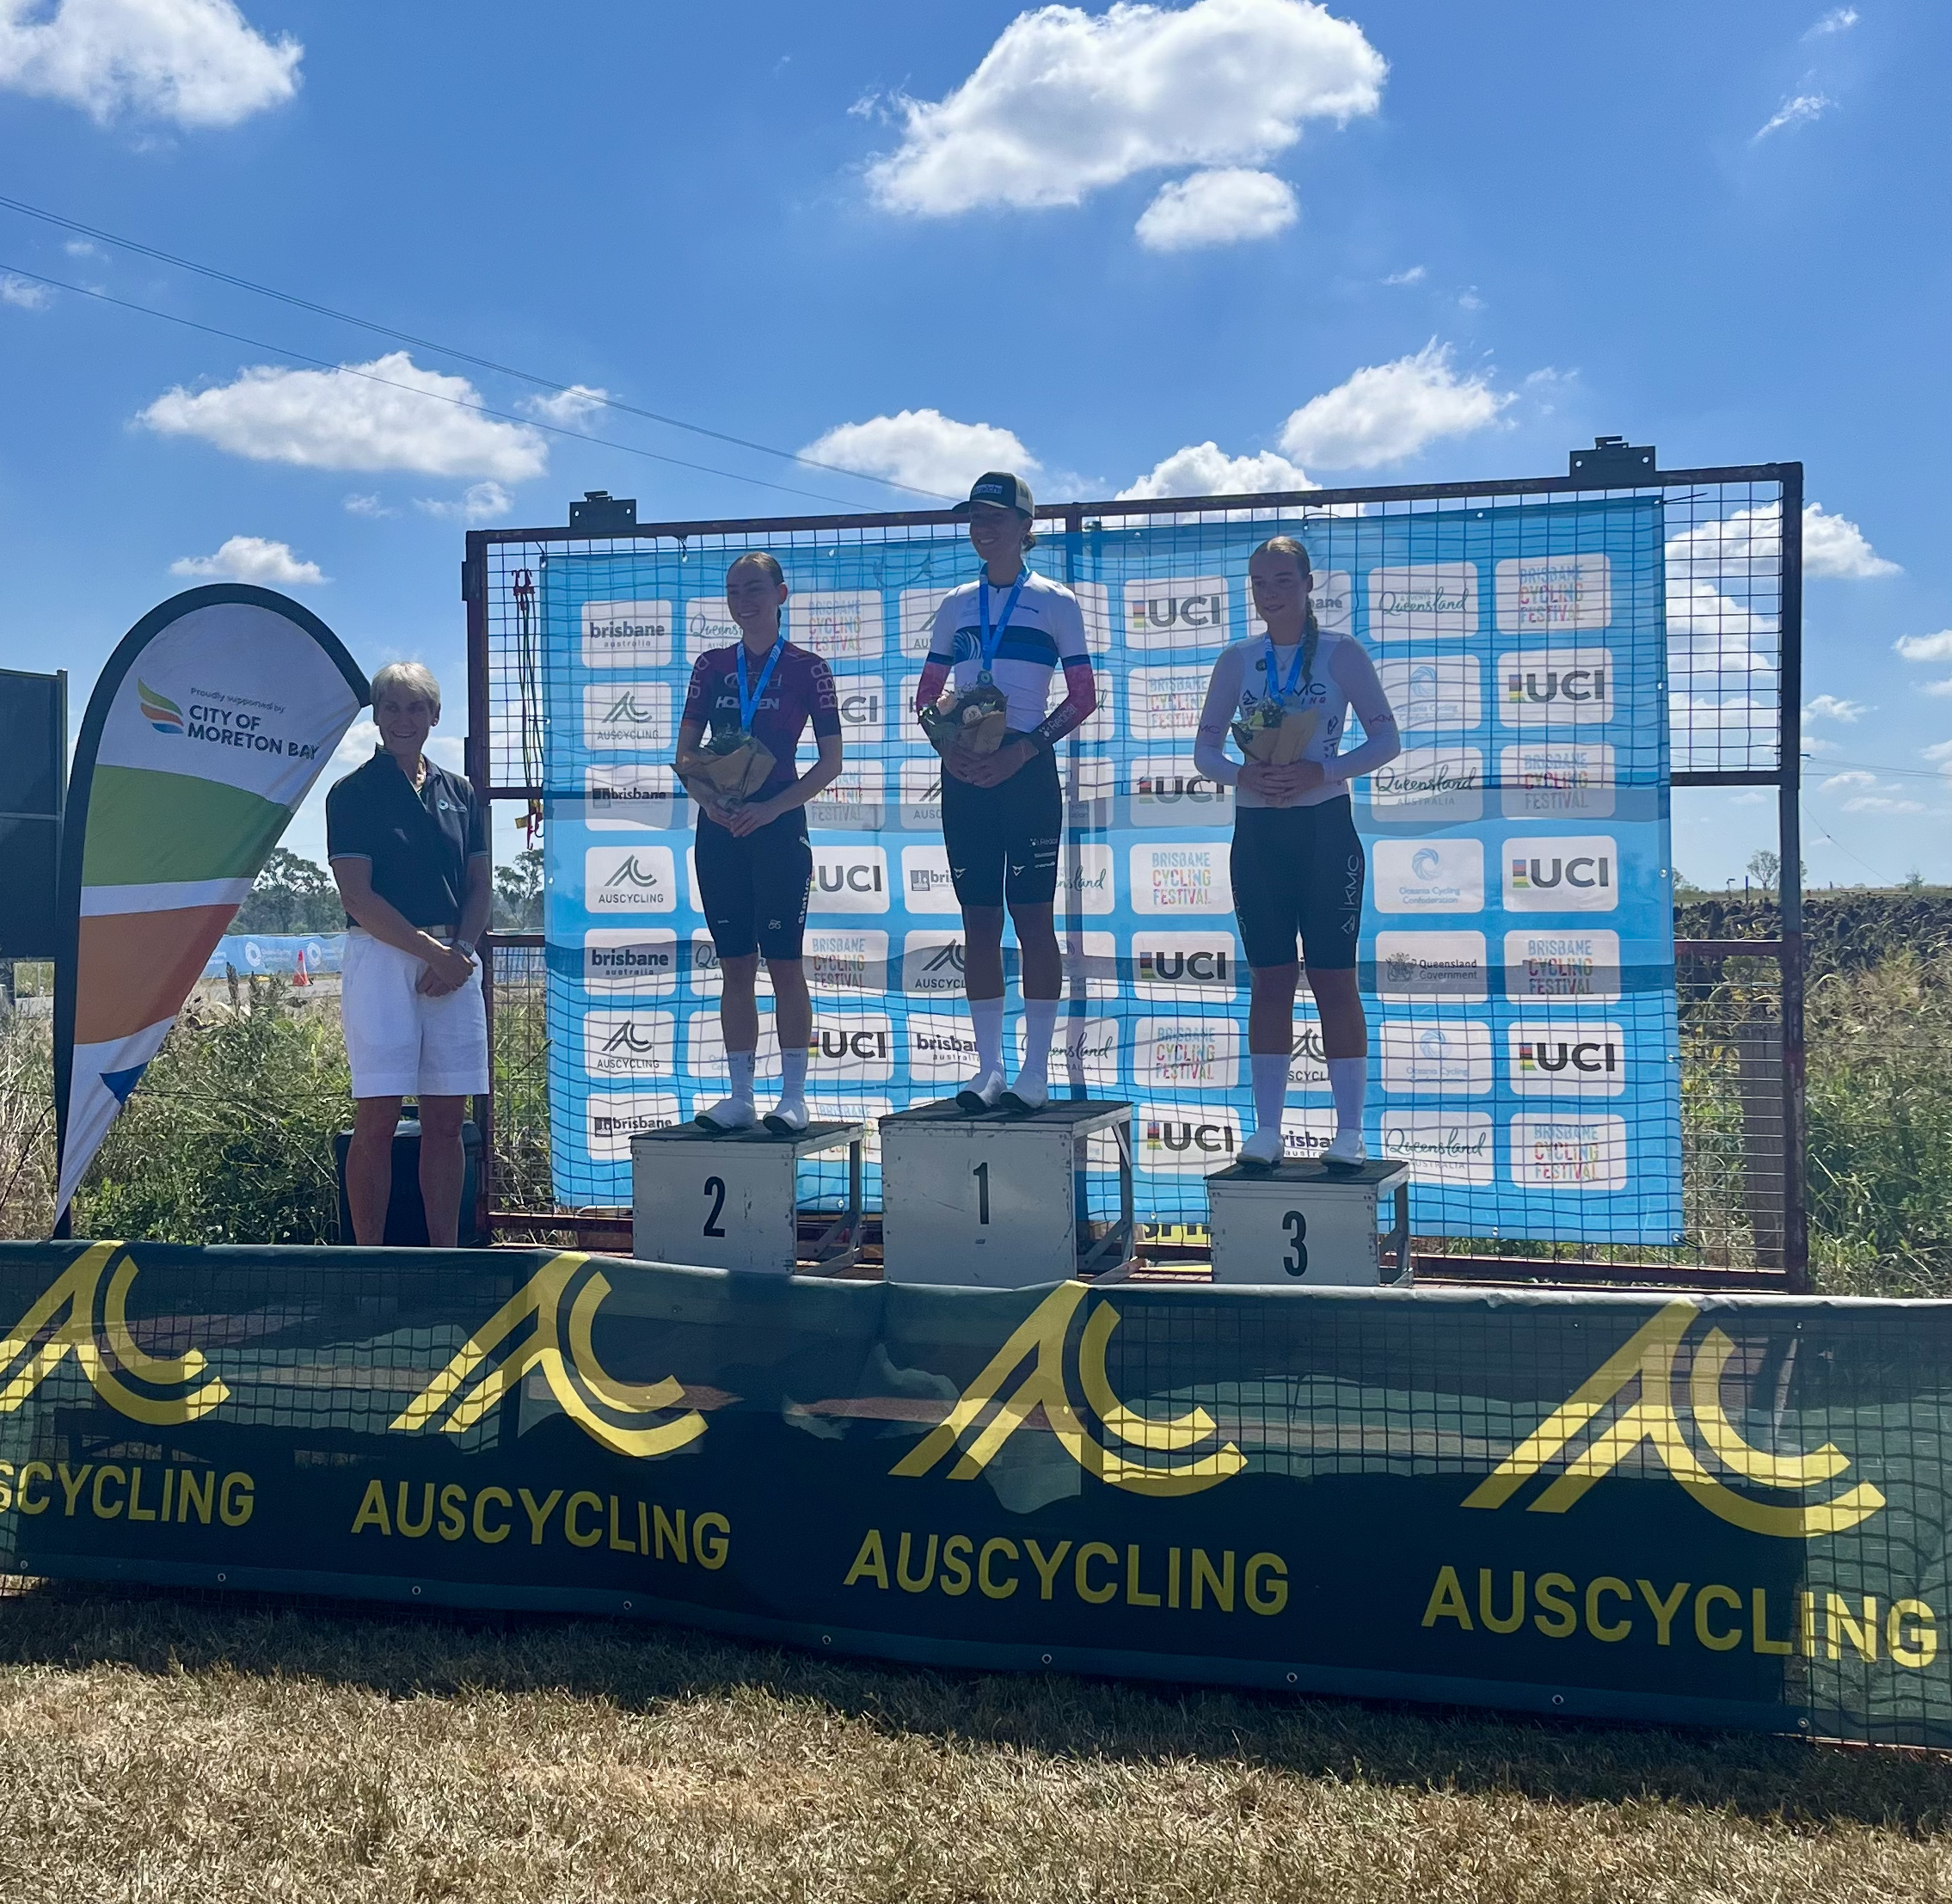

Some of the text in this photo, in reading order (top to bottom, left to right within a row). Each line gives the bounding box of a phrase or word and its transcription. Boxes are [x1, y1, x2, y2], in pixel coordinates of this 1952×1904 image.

[1379, 587, 1469, 616] Queensland
[1148, 596, 1220, 628] UCI
[589, 621, 665, 638] brisbane
[690, 613, 743, 638] Queens
[190, 688, 225, 702] Proudly
[1526, 670, 1604, 703] UCI
[189, 704, 261, 731] CITY OF
[841, 695, 878, 723] CI
[187, 722, 320, 760] MORETON BAY
[597, 730, 659, 740] AUSCYCLING
[1156, 775, 1225, 803] UCI
[1376, 765, 1476, 795] Queensland
[611, 788, 666, 800] brisbane
[1398, 797, 1455, 806] AUSTRALIA
[1525, 793, 1589, 809] FESTIVAL
[1152, 851, 1211, 868] BRISBANE
[819, 865, 881, 892] UCI
[1152, 869, 1212, 887] CYCLING
[1344, 854, 1360, 906] KMC
[1531, 857, 1608, 888] UCI
[598, 894, 664, 904] AUSCYCLING
[1153, 889, 1212, 906] FESTIVAL
[1432, 887, 1460, 896] Cycling
[812, 938, 866, 953] BRISBANE
[1528, 940, 1593, 955] BRISBANE
[592, 949, 669, 967] brisbane
[813, 955, 865, 972] CYCLING
[1156, 951, 1226, 980] UCI
[1420, 959, 1477, 969] Queensland
[1528, 958, 1593, 977] CYCLING
[605, 967, 654, 975] australia
[1420, 970, 1477, 980] Government
[915, 978, 966, 989] AUSCYCL
[1529, 979, 1594, 995] FESTIVAL
[822, 1031, 887, 1059] UCI
[917, 1033, 978, 1052] brisba
[1157, 1044, 1215, 1061] CYCLING
[1537, 1043, 1615, 1072] UCI
[597, 1059, 660, 1069] AUSCYCLING
[1156, 1063, 1214, 1080] FESTIVAL
[1287, 1071, 1329, 1081] SCYCL
[613, 1117, 672, 1130] brisbane
[1163, 1121, 1234, 1152] UCI
[1385, 1128, 1486, 1158] Queensland
[972, 1162, 990, 1225] 1
[703, 1176, 726, 1238] 2
[1282, 1211, 1308, 1277] 3
[0, 1458, 255, 1529] SCYCLING
[351, 1479, 731, 1571] AUSCYCLING
[843, 1528, 1289, 1616] AUSCYCLING
[1421, 1564, 1938, 1668] AUSCYCLING
